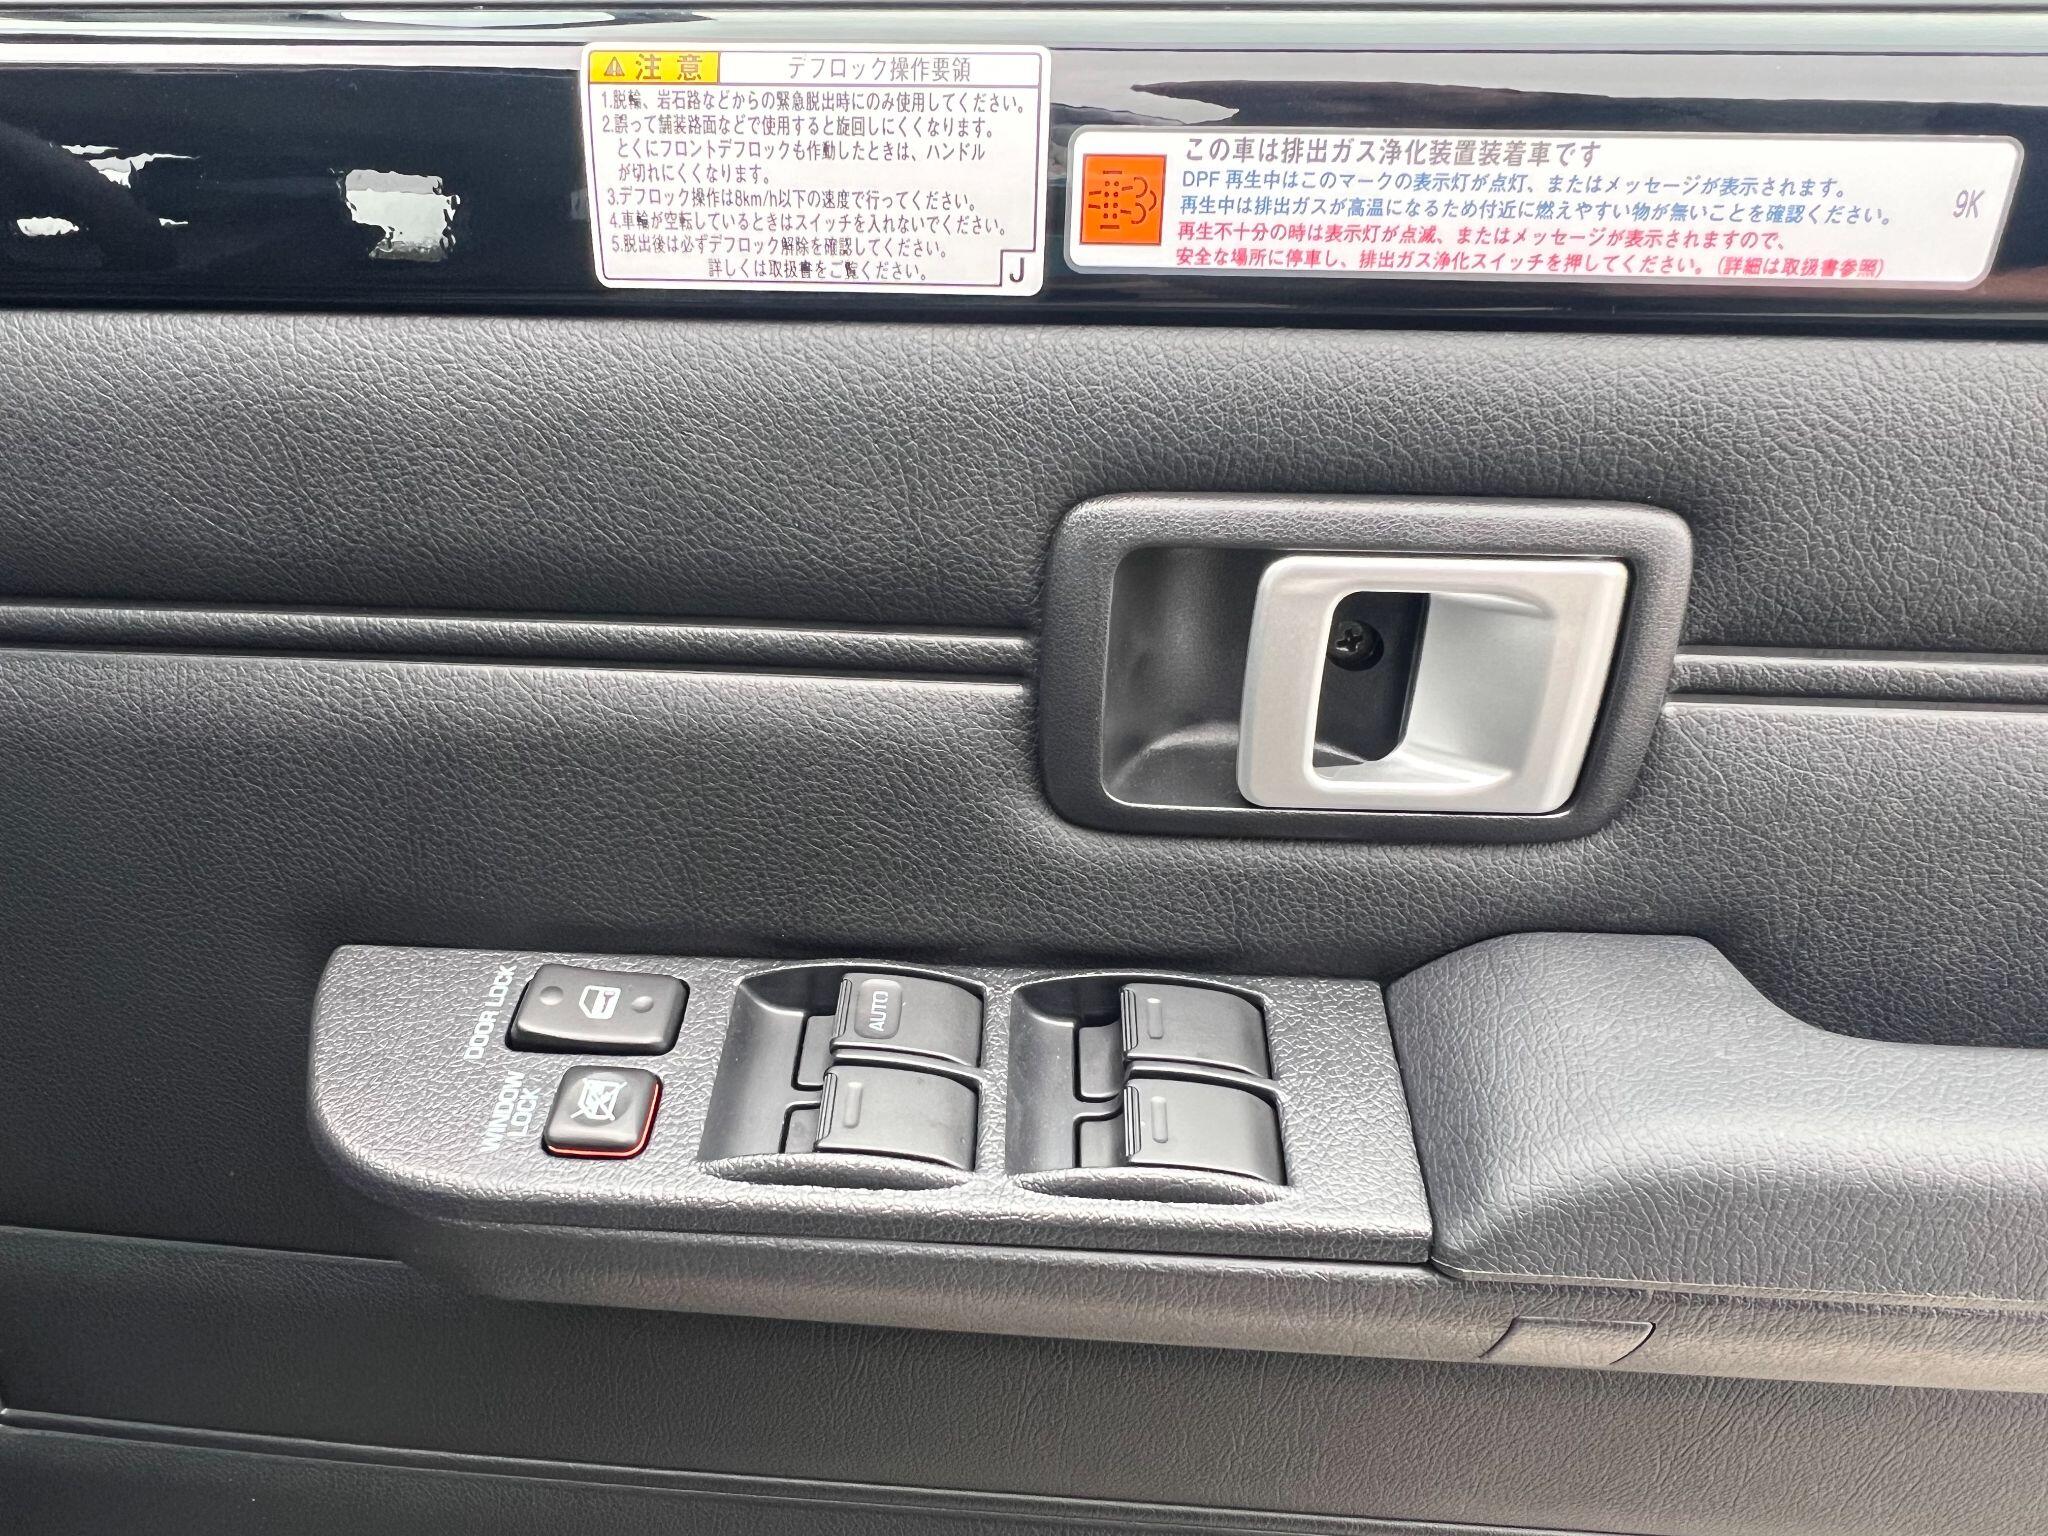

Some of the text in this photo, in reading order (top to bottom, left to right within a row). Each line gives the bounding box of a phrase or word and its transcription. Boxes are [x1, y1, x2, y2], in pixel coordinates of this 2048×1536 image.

[788, 55, 971, 82] デフロック操作要領
[1186, 136, 1601, 168] この車は排出ガス浄化装置装着車です
[619, 162, 769, 185] が切れにくくなります。
[1952, 189, 1986, 219] 9K
[1009, 257, 1025, 283] J
[463, 965, 518, 1061] DOOR LOCK
[868, 990, 889, 1032] AUTO
[481, 1070, 525, 1152] WINDOW
[507, 1087, 541, 1138] LOCK
